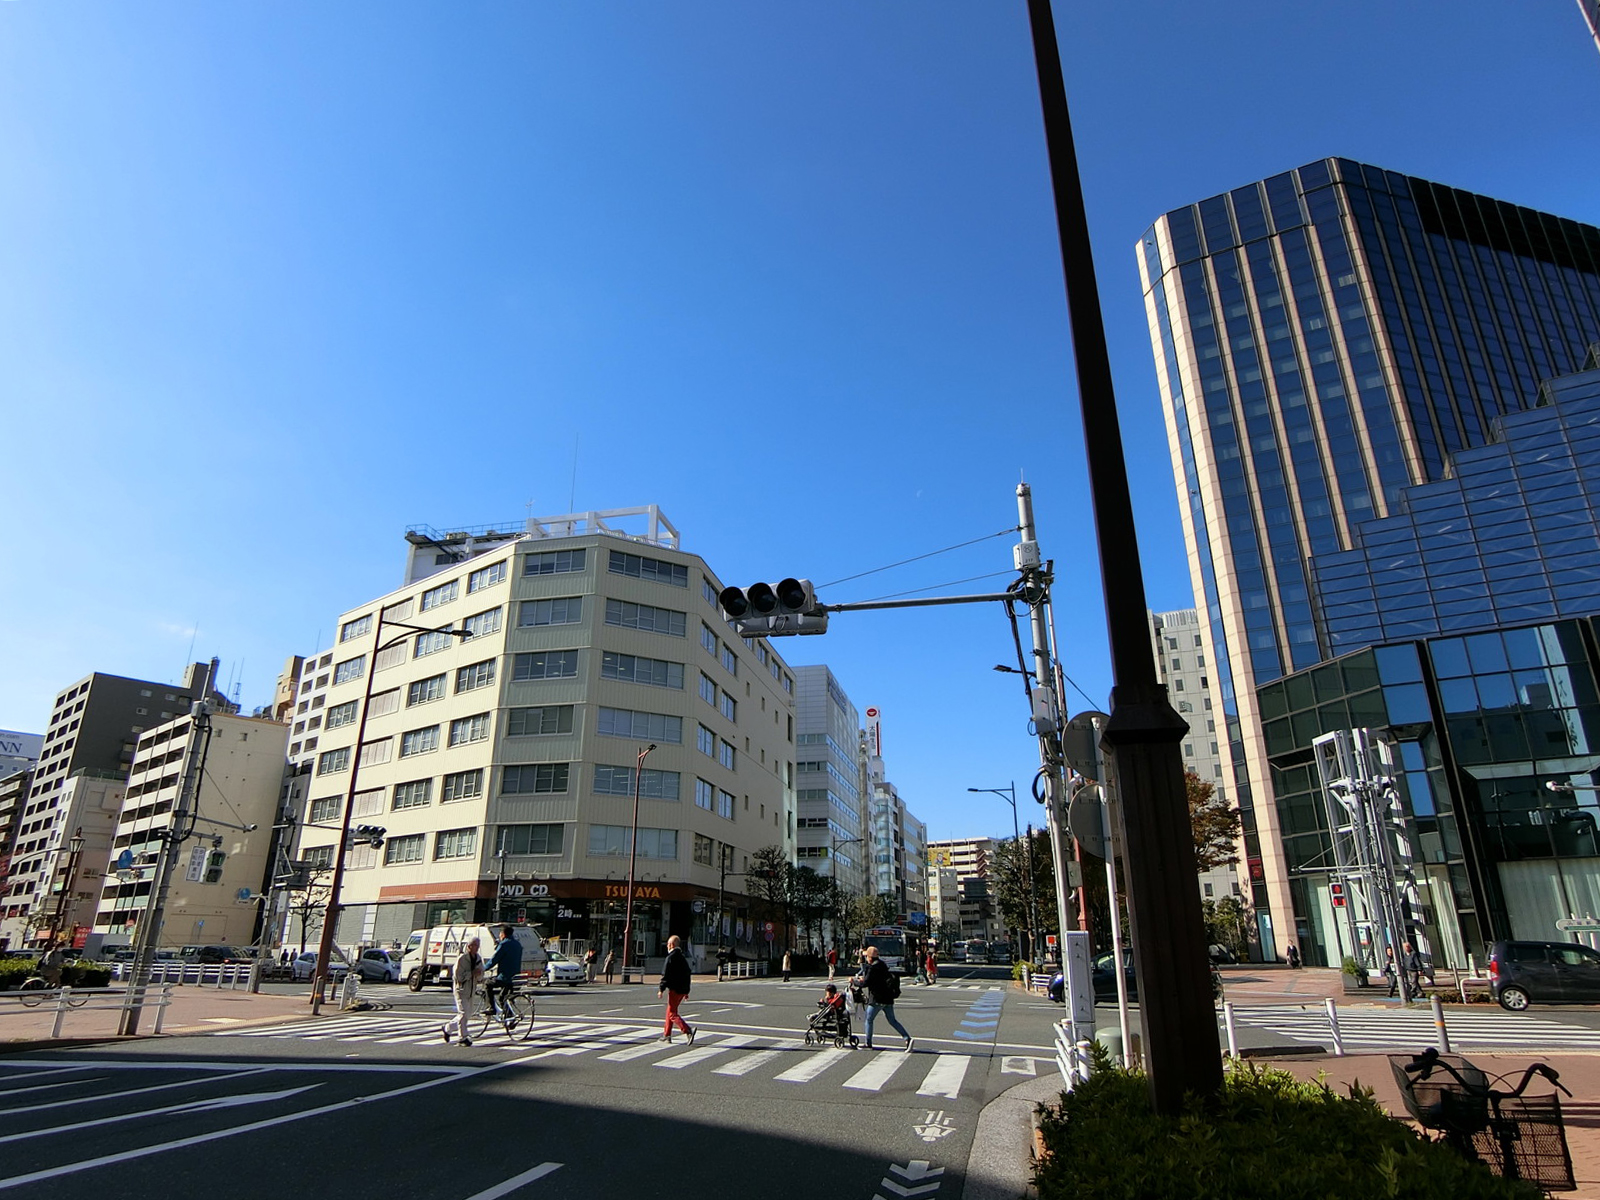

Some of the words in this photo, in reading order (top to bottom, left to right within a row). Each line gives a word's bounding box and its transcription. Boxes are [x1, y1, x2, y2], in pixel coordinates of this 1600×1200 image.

[500, 884, 525, 896] DVD
[530, 884, 549, 896] CD
[605, 885, 661, 898] TSUAYA
